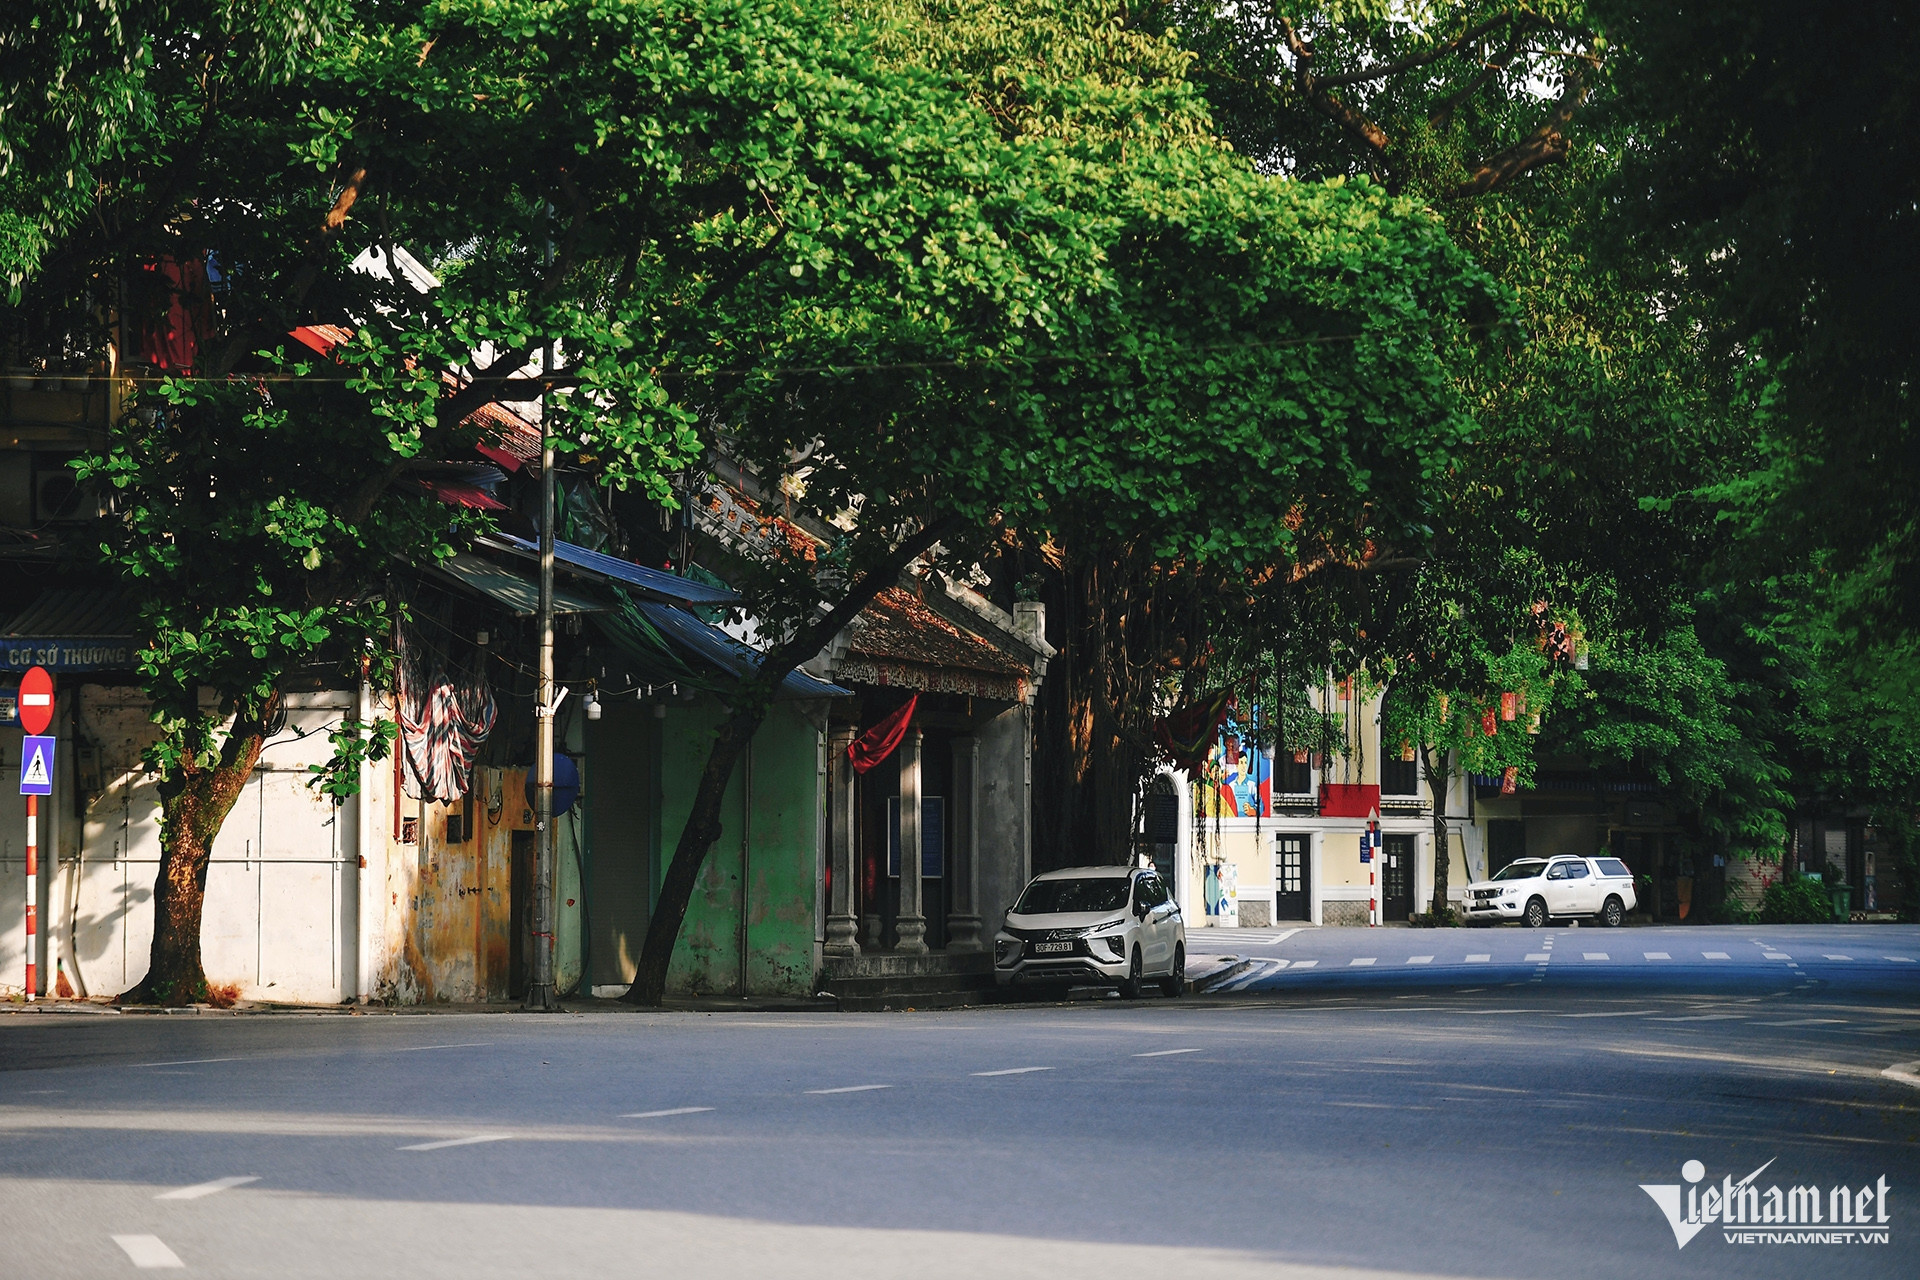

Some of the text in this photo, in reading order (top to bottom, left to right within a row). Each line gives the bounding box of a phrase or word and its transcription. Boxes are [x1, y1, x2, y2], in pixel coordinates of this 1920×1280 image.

[9, 647, 32, 666] CƠ
[36, 643, 59, 666] SỞ
[63, 646, 127, 665] THƯƠNG
